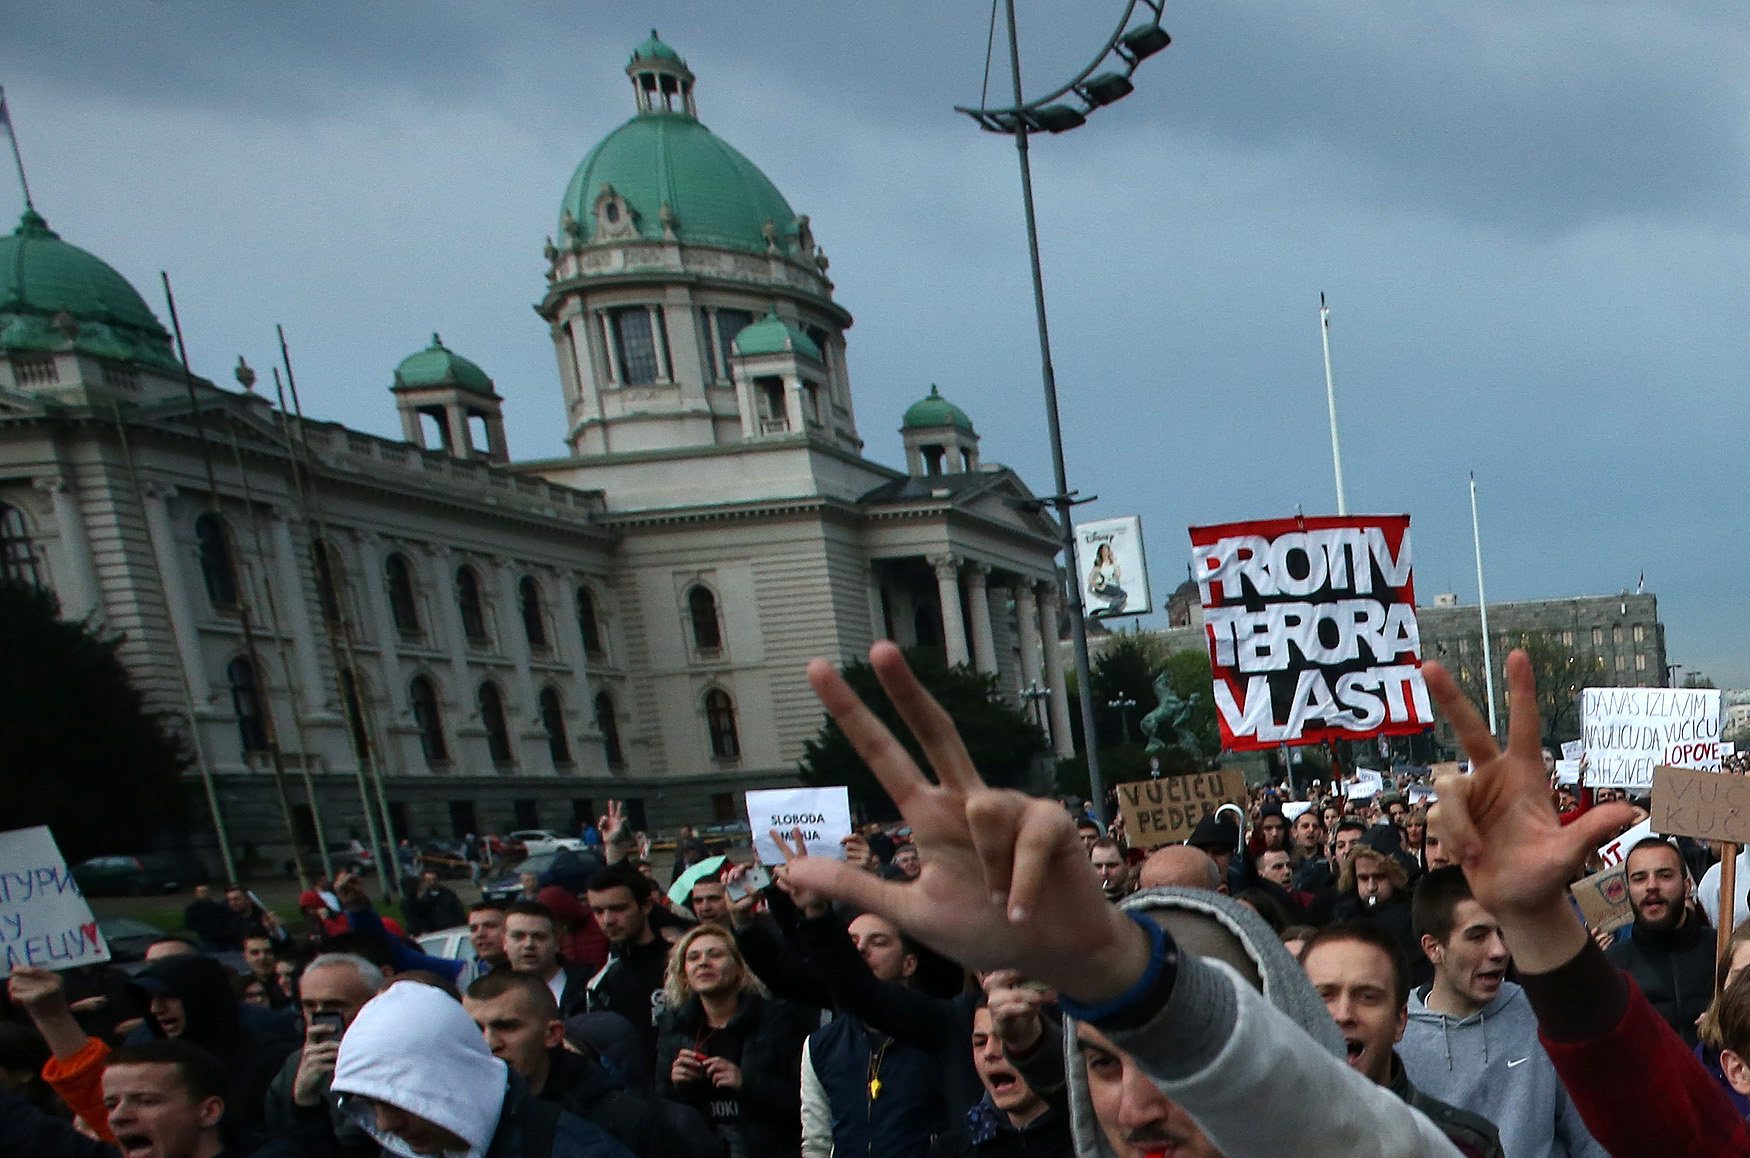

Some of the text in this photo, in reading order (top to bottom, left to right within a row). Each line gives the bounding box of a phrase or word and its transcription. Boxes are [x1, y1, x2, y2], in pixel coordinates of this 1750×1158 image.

[1193, 527, 1414, 605] PROTIV
[1203, 598, 1422, 673] TERORA
[1213, 664, 1435, 742] VLASTI
[1664, 742, 1720, 767] LOPOVE
[771, 812, 825, 826] SLOBODA
[0, 867, 81, 904] ТУРИ
